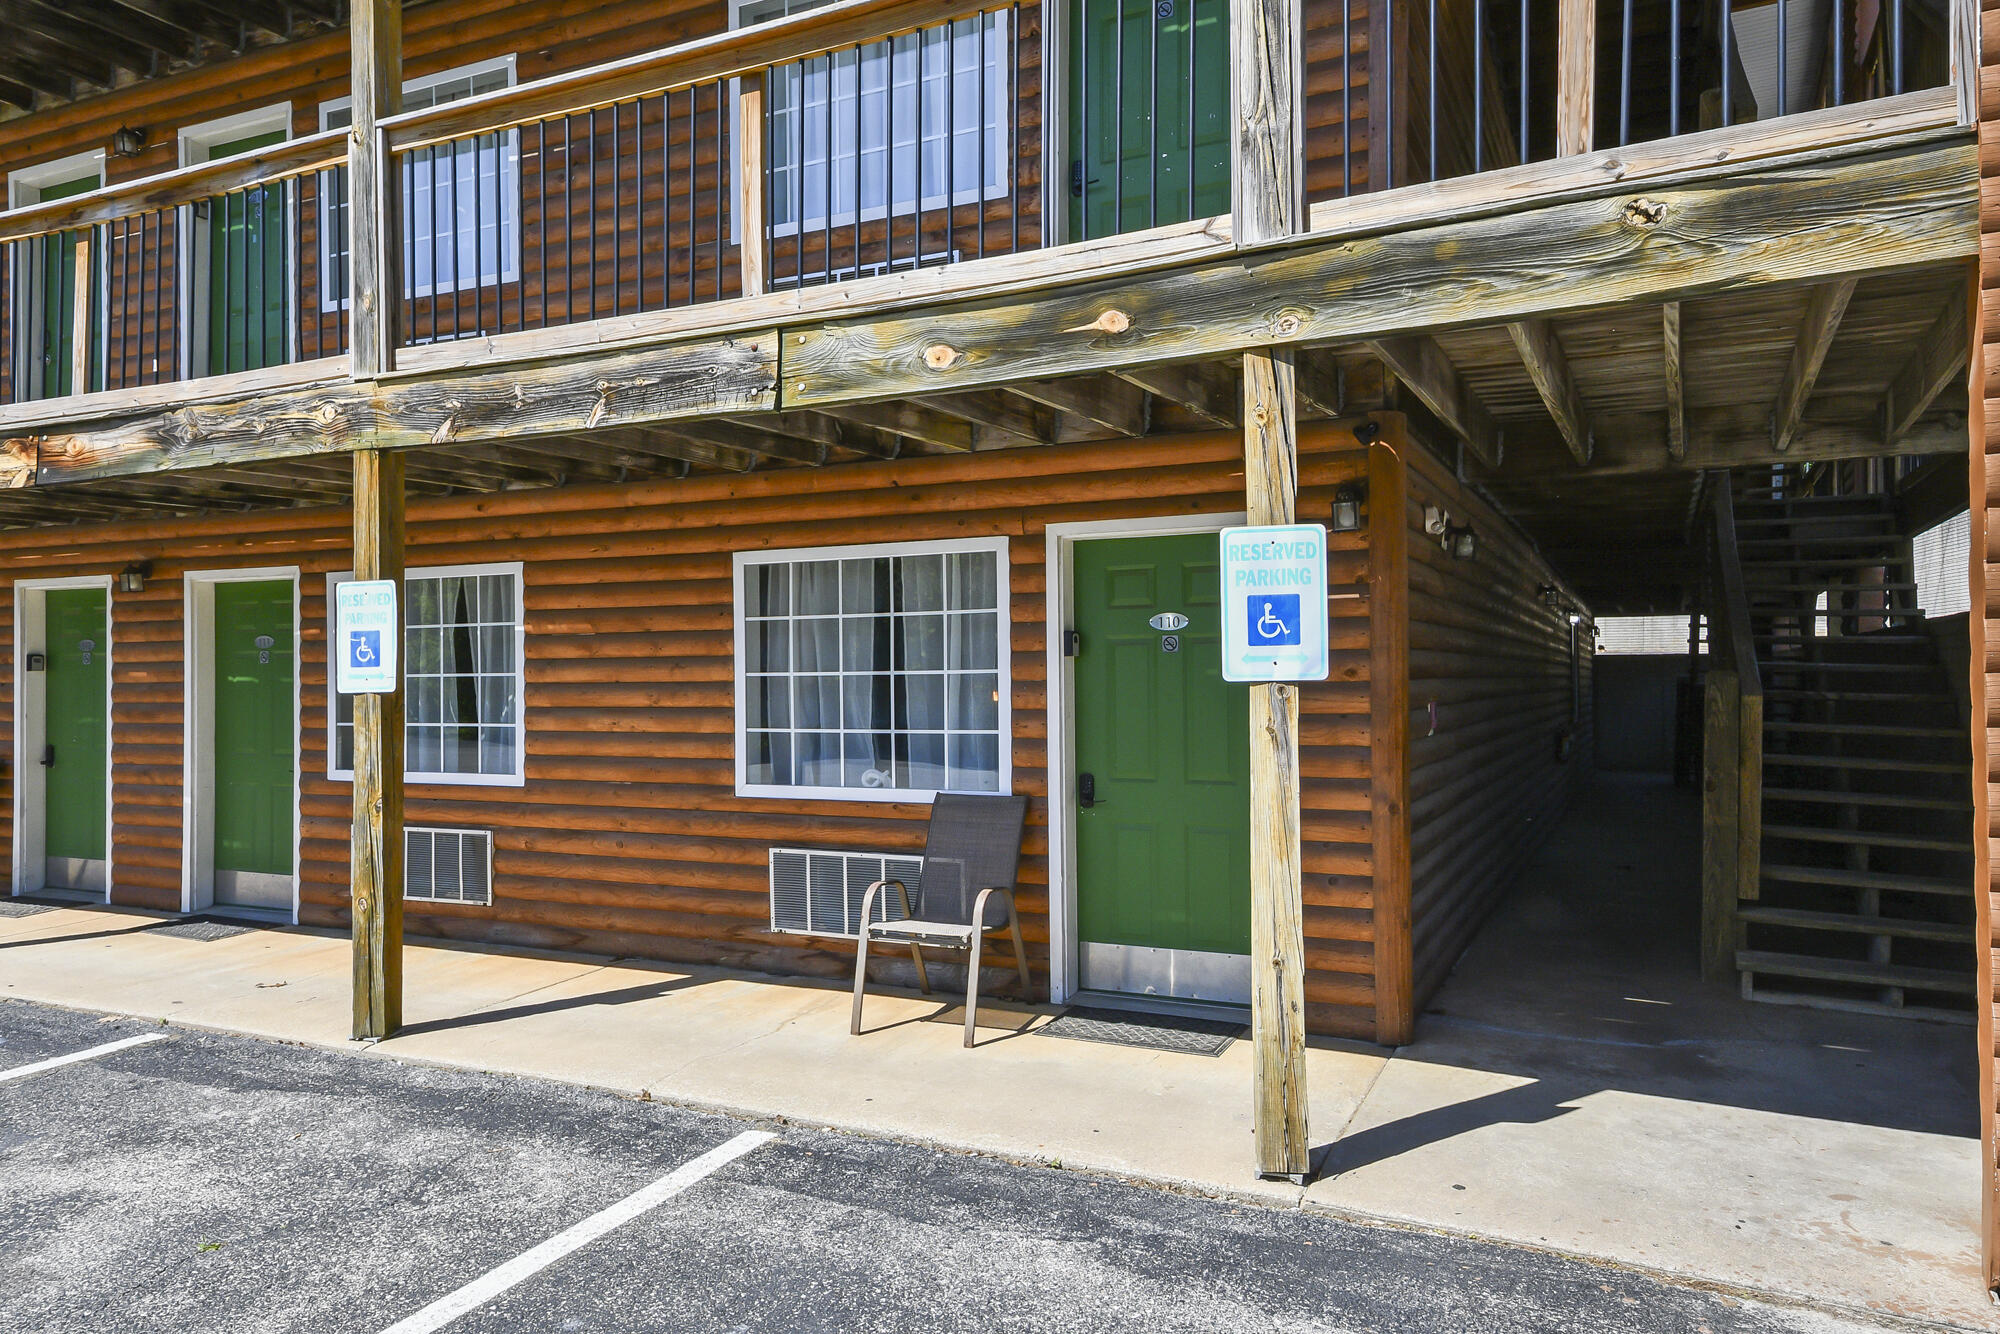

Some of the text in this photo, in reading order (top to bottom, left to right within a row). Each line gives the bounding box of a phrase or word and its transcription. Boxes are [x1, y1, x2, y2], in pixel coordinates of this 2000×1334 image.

[1229, 542, 1317, 561] RESERVED
[1236, 568, 1312, 587] PARKING
[1159, 615, 1180, 628] 110
